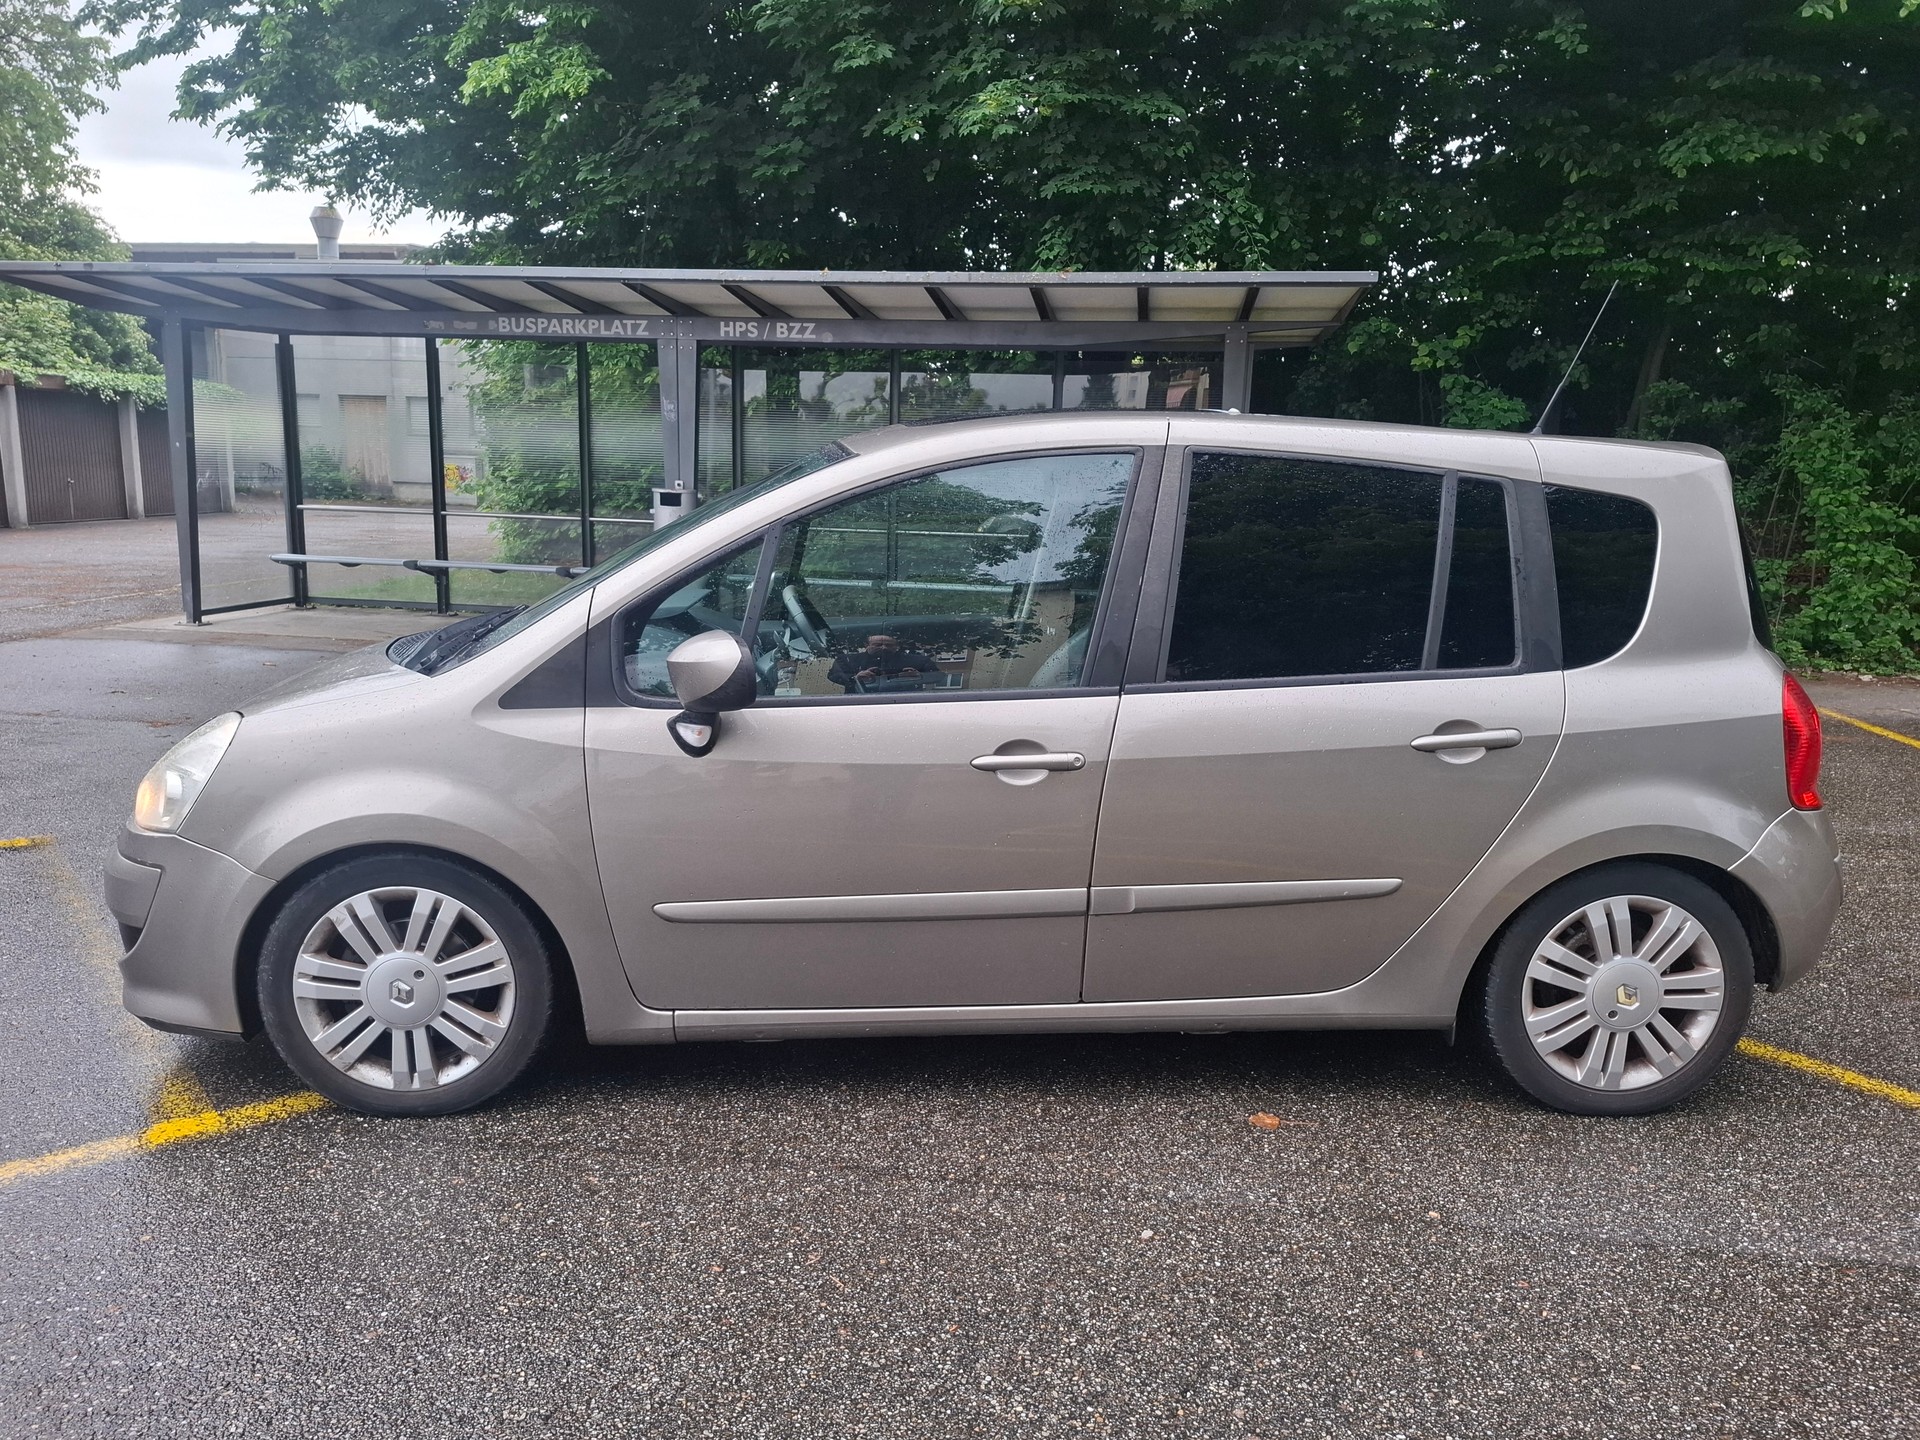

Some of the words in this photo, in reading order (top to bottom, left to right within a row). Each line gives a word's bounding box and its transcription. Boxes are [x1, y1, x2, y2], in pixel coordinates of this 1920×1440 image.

[498, 317, 649, 336] BUSPARKPLATZ
[720, 321, 758, 338] HPS
[763, 322, 771, 340] /
[776, 322, 816, 339] BZZ
